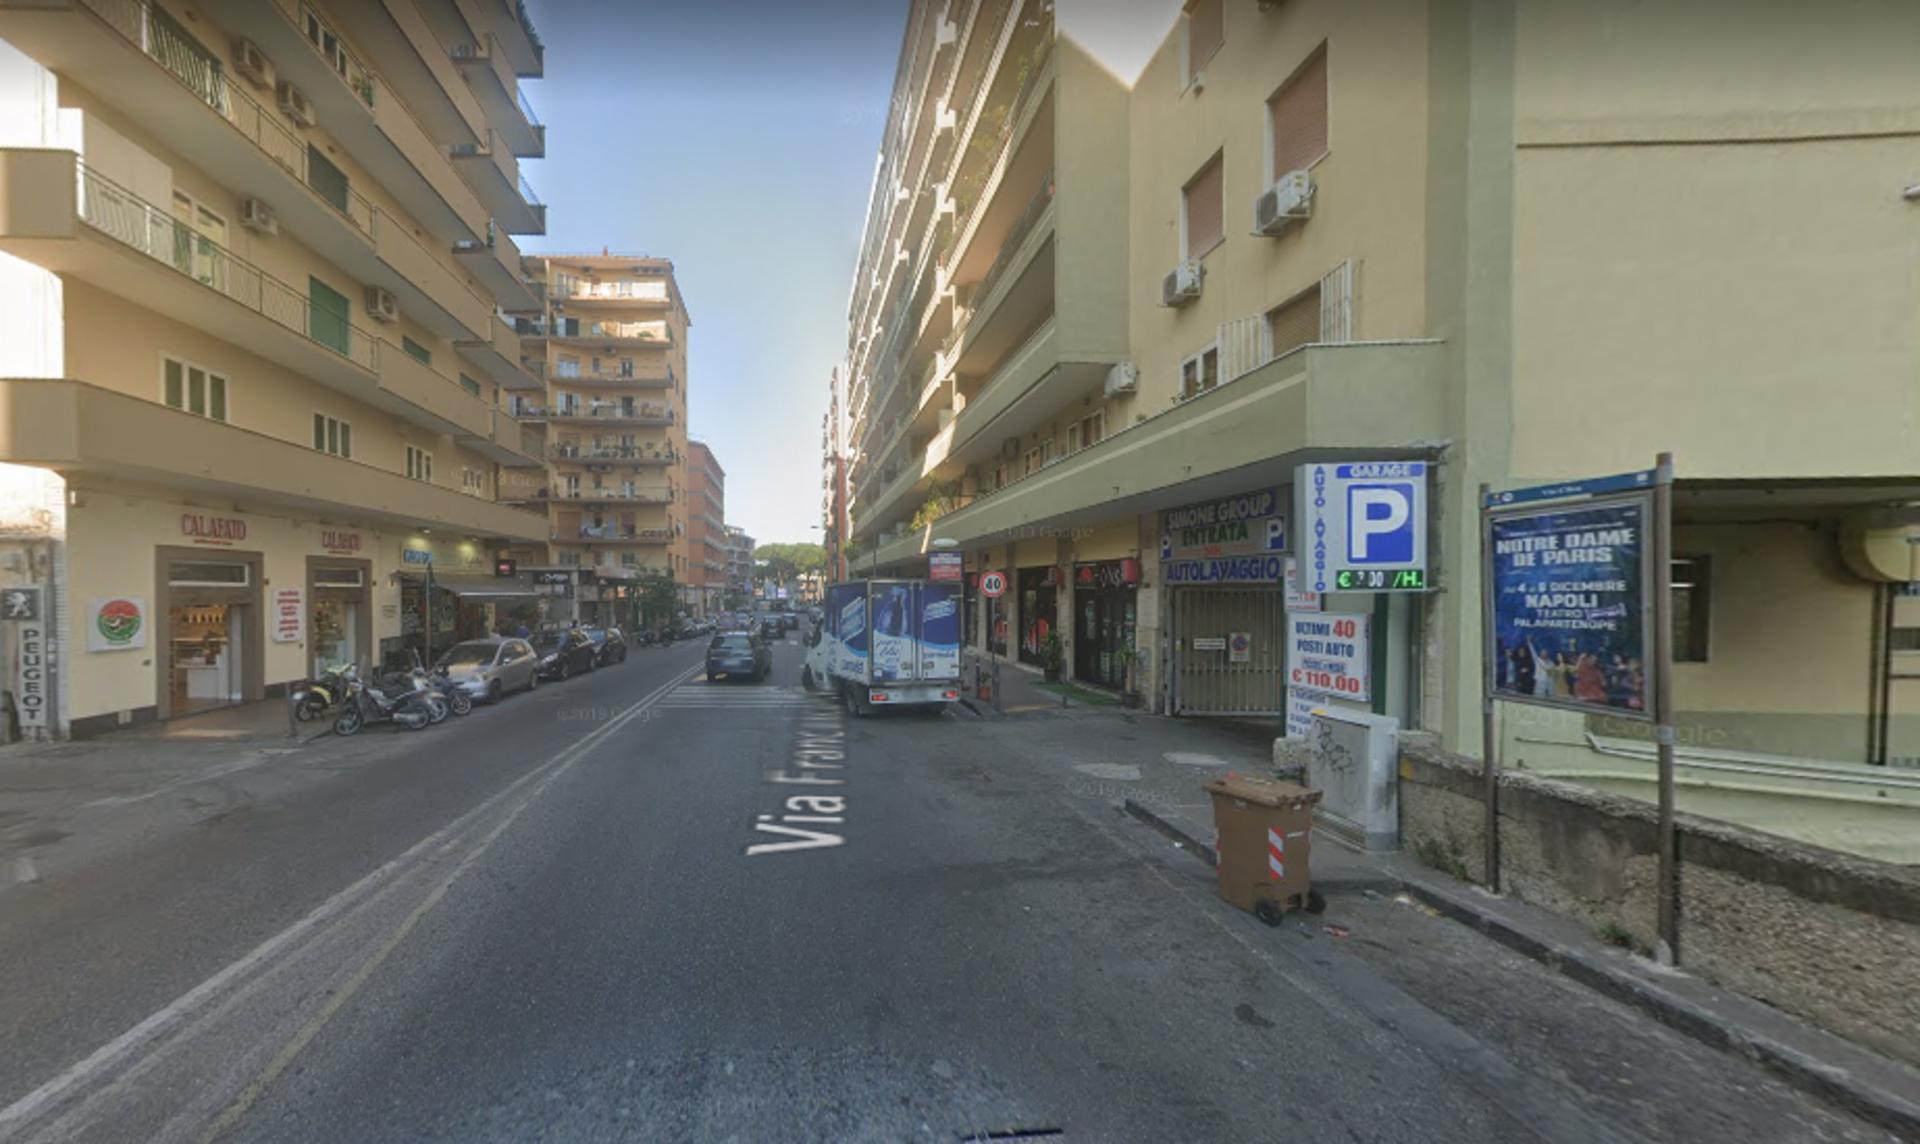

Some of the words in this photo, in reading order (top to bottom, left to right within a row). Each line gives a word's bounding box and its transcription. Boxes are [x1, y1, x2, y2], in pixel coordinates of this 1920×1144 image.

[1350, 464, 1411, 477] GARAGE
[1168, 505, 1215, 529] SIMONE
[1218, 493, 1271, 521] GROUP
[1351, 488, 1409, 559] P
[1183, 521, 1248, 547] ENTRATA
[1497, 534, 1559, 554] NOTRE
[1565, 527, 1636, 549] DAME
[1513, 553, 1536, 567] DE
[1542, 547, 1613, 565] PARIS
[1167, 557, 1280, 581] AUTOLAVAGGIO
[985, 573, 1000, 589] 40
[1338, 571, 1352, 588] €
[1518, 583, 1526, 592] 4
[1550, 580, 1627, 592] DICEMBRE
[1525, 594, 1598, 608] NAPOLI
[1536, 609, 1582, 619] TEATRO
[1333, 620, 1355, 638] 40
[1325, 642, 1355, 657] AUTO
[22, 628, 42, 720] PEUGEOT
